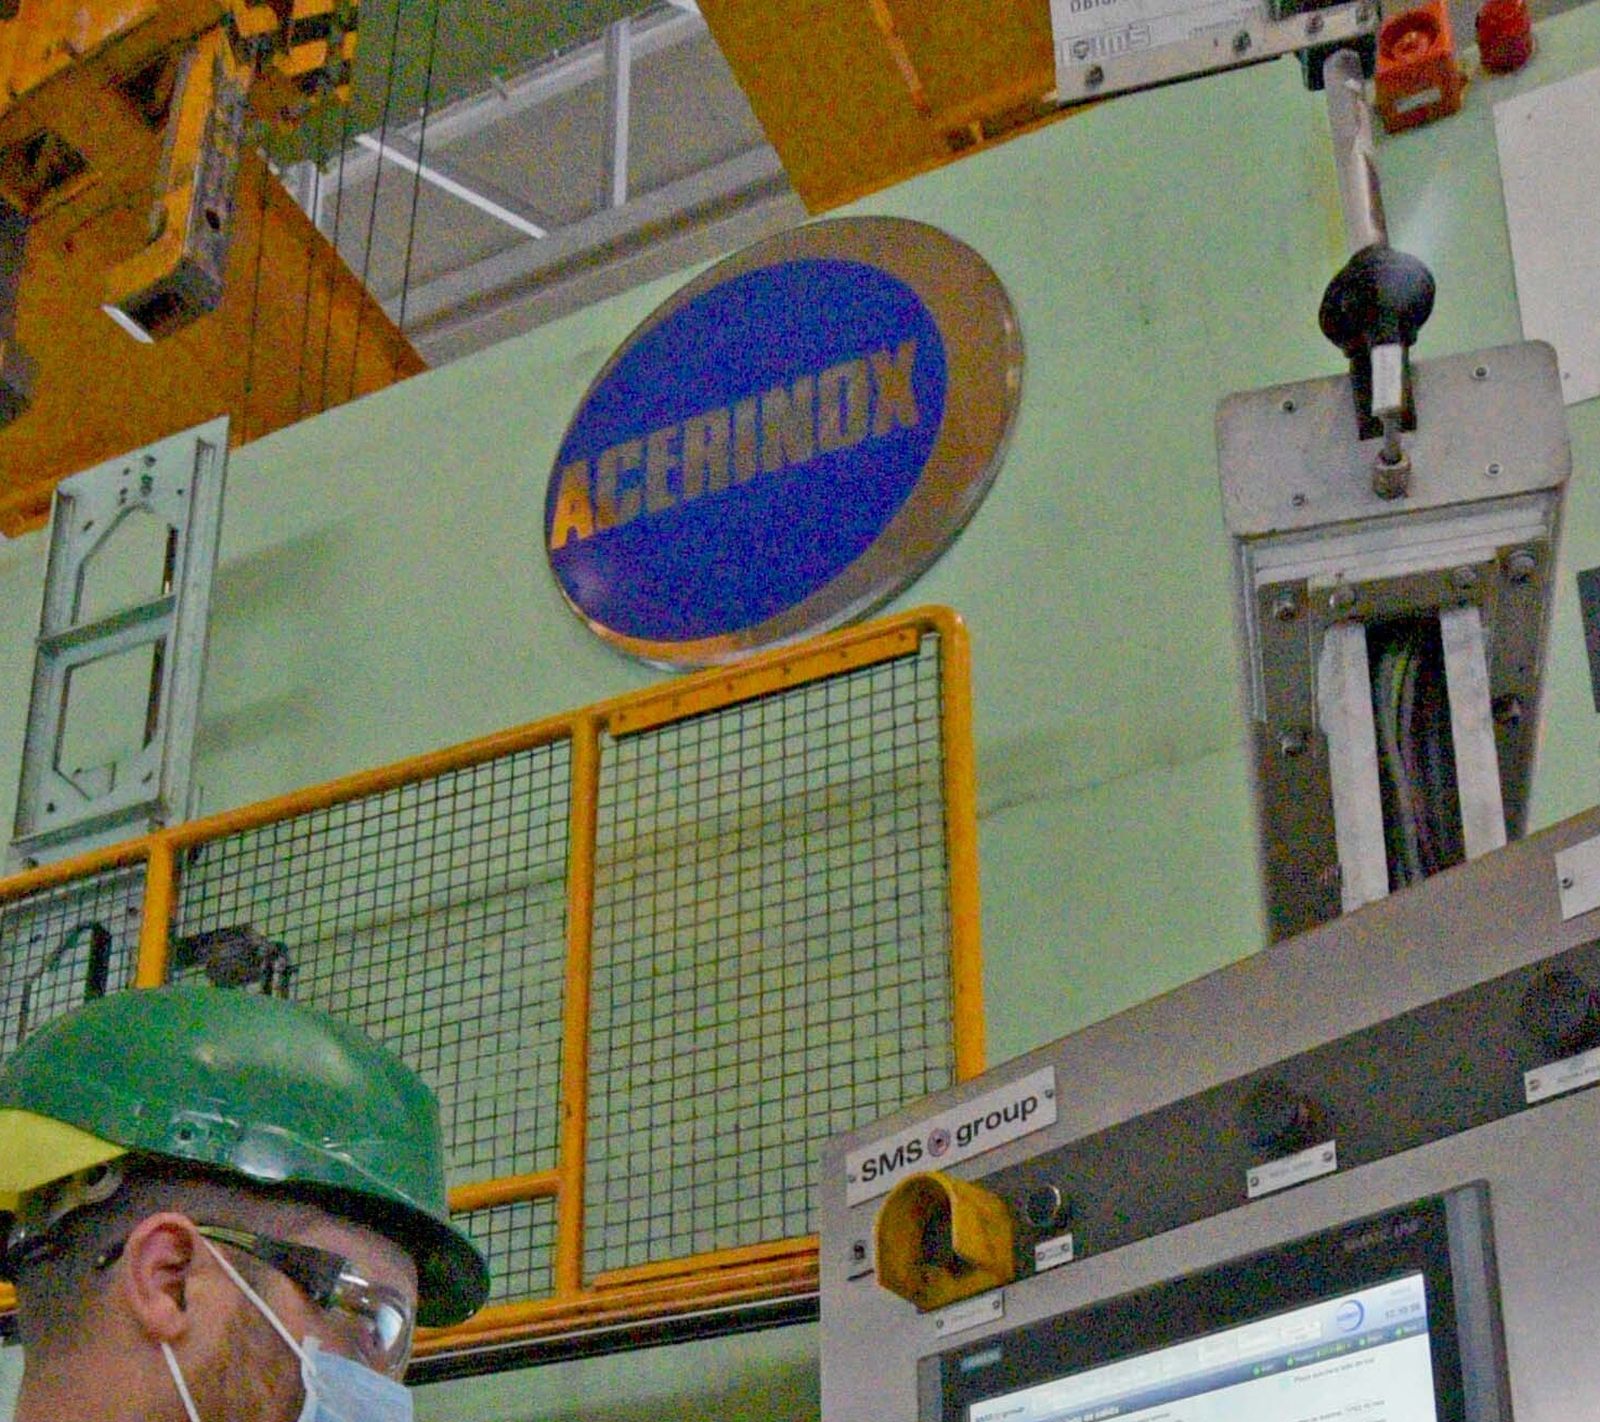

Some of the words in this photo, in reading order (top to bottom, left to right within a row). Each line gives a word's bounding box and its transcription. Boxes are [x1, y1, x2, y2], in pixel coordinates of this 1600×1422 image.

[551, 340, 920, 550] ACERINOX
[861, 1139, 923, 1182] SMS
[956, 1095, 1038, 1148] group
